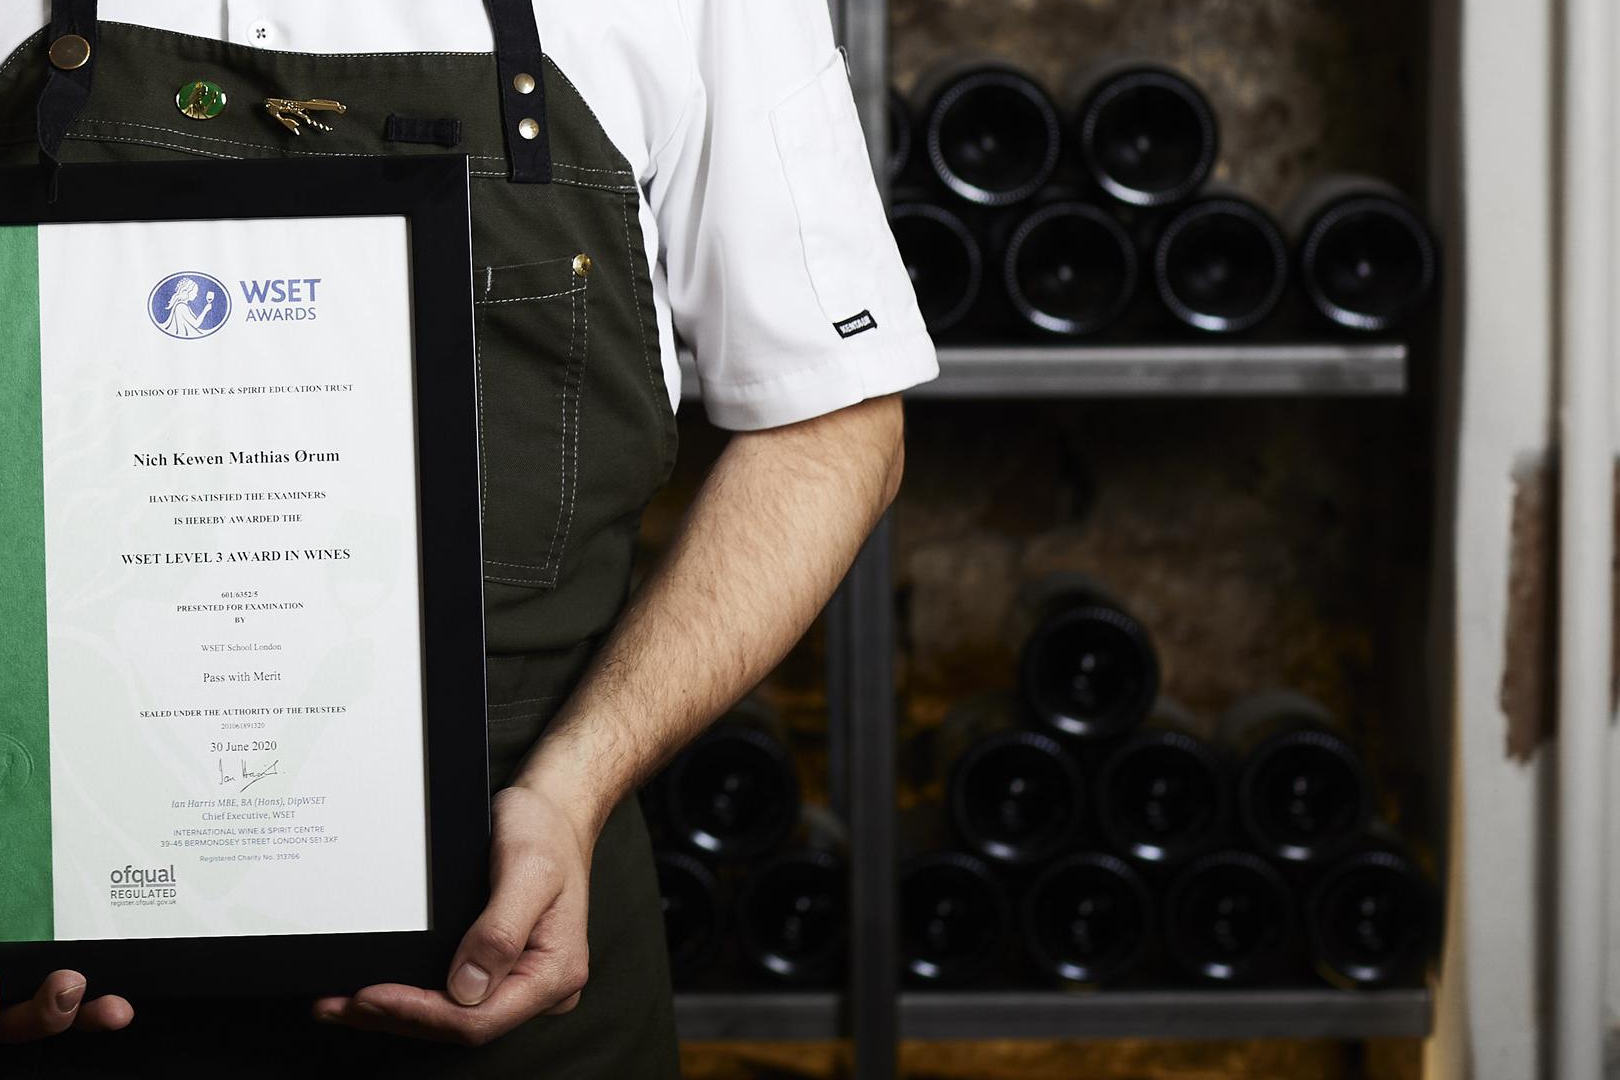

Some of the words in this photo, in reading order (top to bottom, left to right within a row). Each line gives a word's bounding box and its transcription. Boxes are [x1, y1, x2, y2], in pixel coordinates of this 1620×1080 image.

[240, 278, 321, 304] WSET
[246, 306, 316, 322] AWARDS
[124, 389, 164, 397] DIVISION
[166, 388, 179, 396] OF
[181, 388, 199, 396] THE
[202, 387, 225, 395] WINE
[228, 386, 235, 395] &
[237, 386, 265, 394] SPIRIT
[269, 385, 321, 394] EDUCATION
[324, 384, 353, 392] TRUST
[133, 453, 167, 467] Nich
[173, 452, 223, 466] Kewen
[229, 450, 289, 464] Mathias
[294, 449, 339, 463] Ørum
[149, 494, 188, 503] HAVING
[191, 493, 242, 502] SATISFIED
[245, 492, 264, 501] THE
[267, 491, 326, 500] EXAMINERS
[174, 517, 182, 525] IS
[185, 515, 226, 525] HEREBY
[228, 514, 279, 524] AWARDED
[282, 514, 302, 523] THE
[121, 553, 161, 565] WSET
[165, 552, 212, 564] LEVEL
[215, 551, 222, 563] 3
[226, 550, 280, 563] AWARD
[285, 550, 299, 561] IN
[303, 548, 350, 560] WINES
[176, 604, 224, 612] PRESENTED
[226, 603, 243, 611] FOR
[245, 602, 304, 611] EXAMINATION
[234, 616, 245, 624] BY
[201, 643, 225, 653] WSET
[227, 643, 252, 652] School
[254, 642, 281, 651] London
[203, 672, 225, 683] Pass
[228, 671, 250, 682] with
[253, 670, 281, 682] Merit
[139, 710, 171, 718] SEALED
[173, 709, 201, 717] UNDER
[204, 709, 220, 717] THE
[222, 707, 269, 716] AUTHORITY
[272, 707, 284, 715] OF
[286, 706, 302, 714] THE
[305, 705, 346, 714] TRUSTEES
[210, 741, 223, 753] 30
[226, 741, 249, 752] June
[251, 740, 277, 751] 2020
[171, 799, 185, 809] Ian
[188, 799, 215, 808] Harris
[217, 798, 239, 808] MBE,
[240, 798, 252, 807] BA
[288, 795, 326, 807] DipWSET
[202, 810, 225, 821] Chief
[272, 810, 295, 819] WSET
[173, 828, 236, 837] INTERNATIONAL
[237, 827, 258, 835] WINE
[261, 827, 267, 835] &
[268, 825, 293, 835] SPIRIT
[294, 824, 324, 834] CENTRE
[184, 838, 240, 847] BERMONDSEY
[241, 837, 270, 846] STREET
[272, 836, 307, 845] LONDON
[199, 855, 236, 863] Registered
[238, 854, 262, 863] Charity
[111, 865, 176, 887] ofqual
[111, 889, 177, 899] REGULATED
